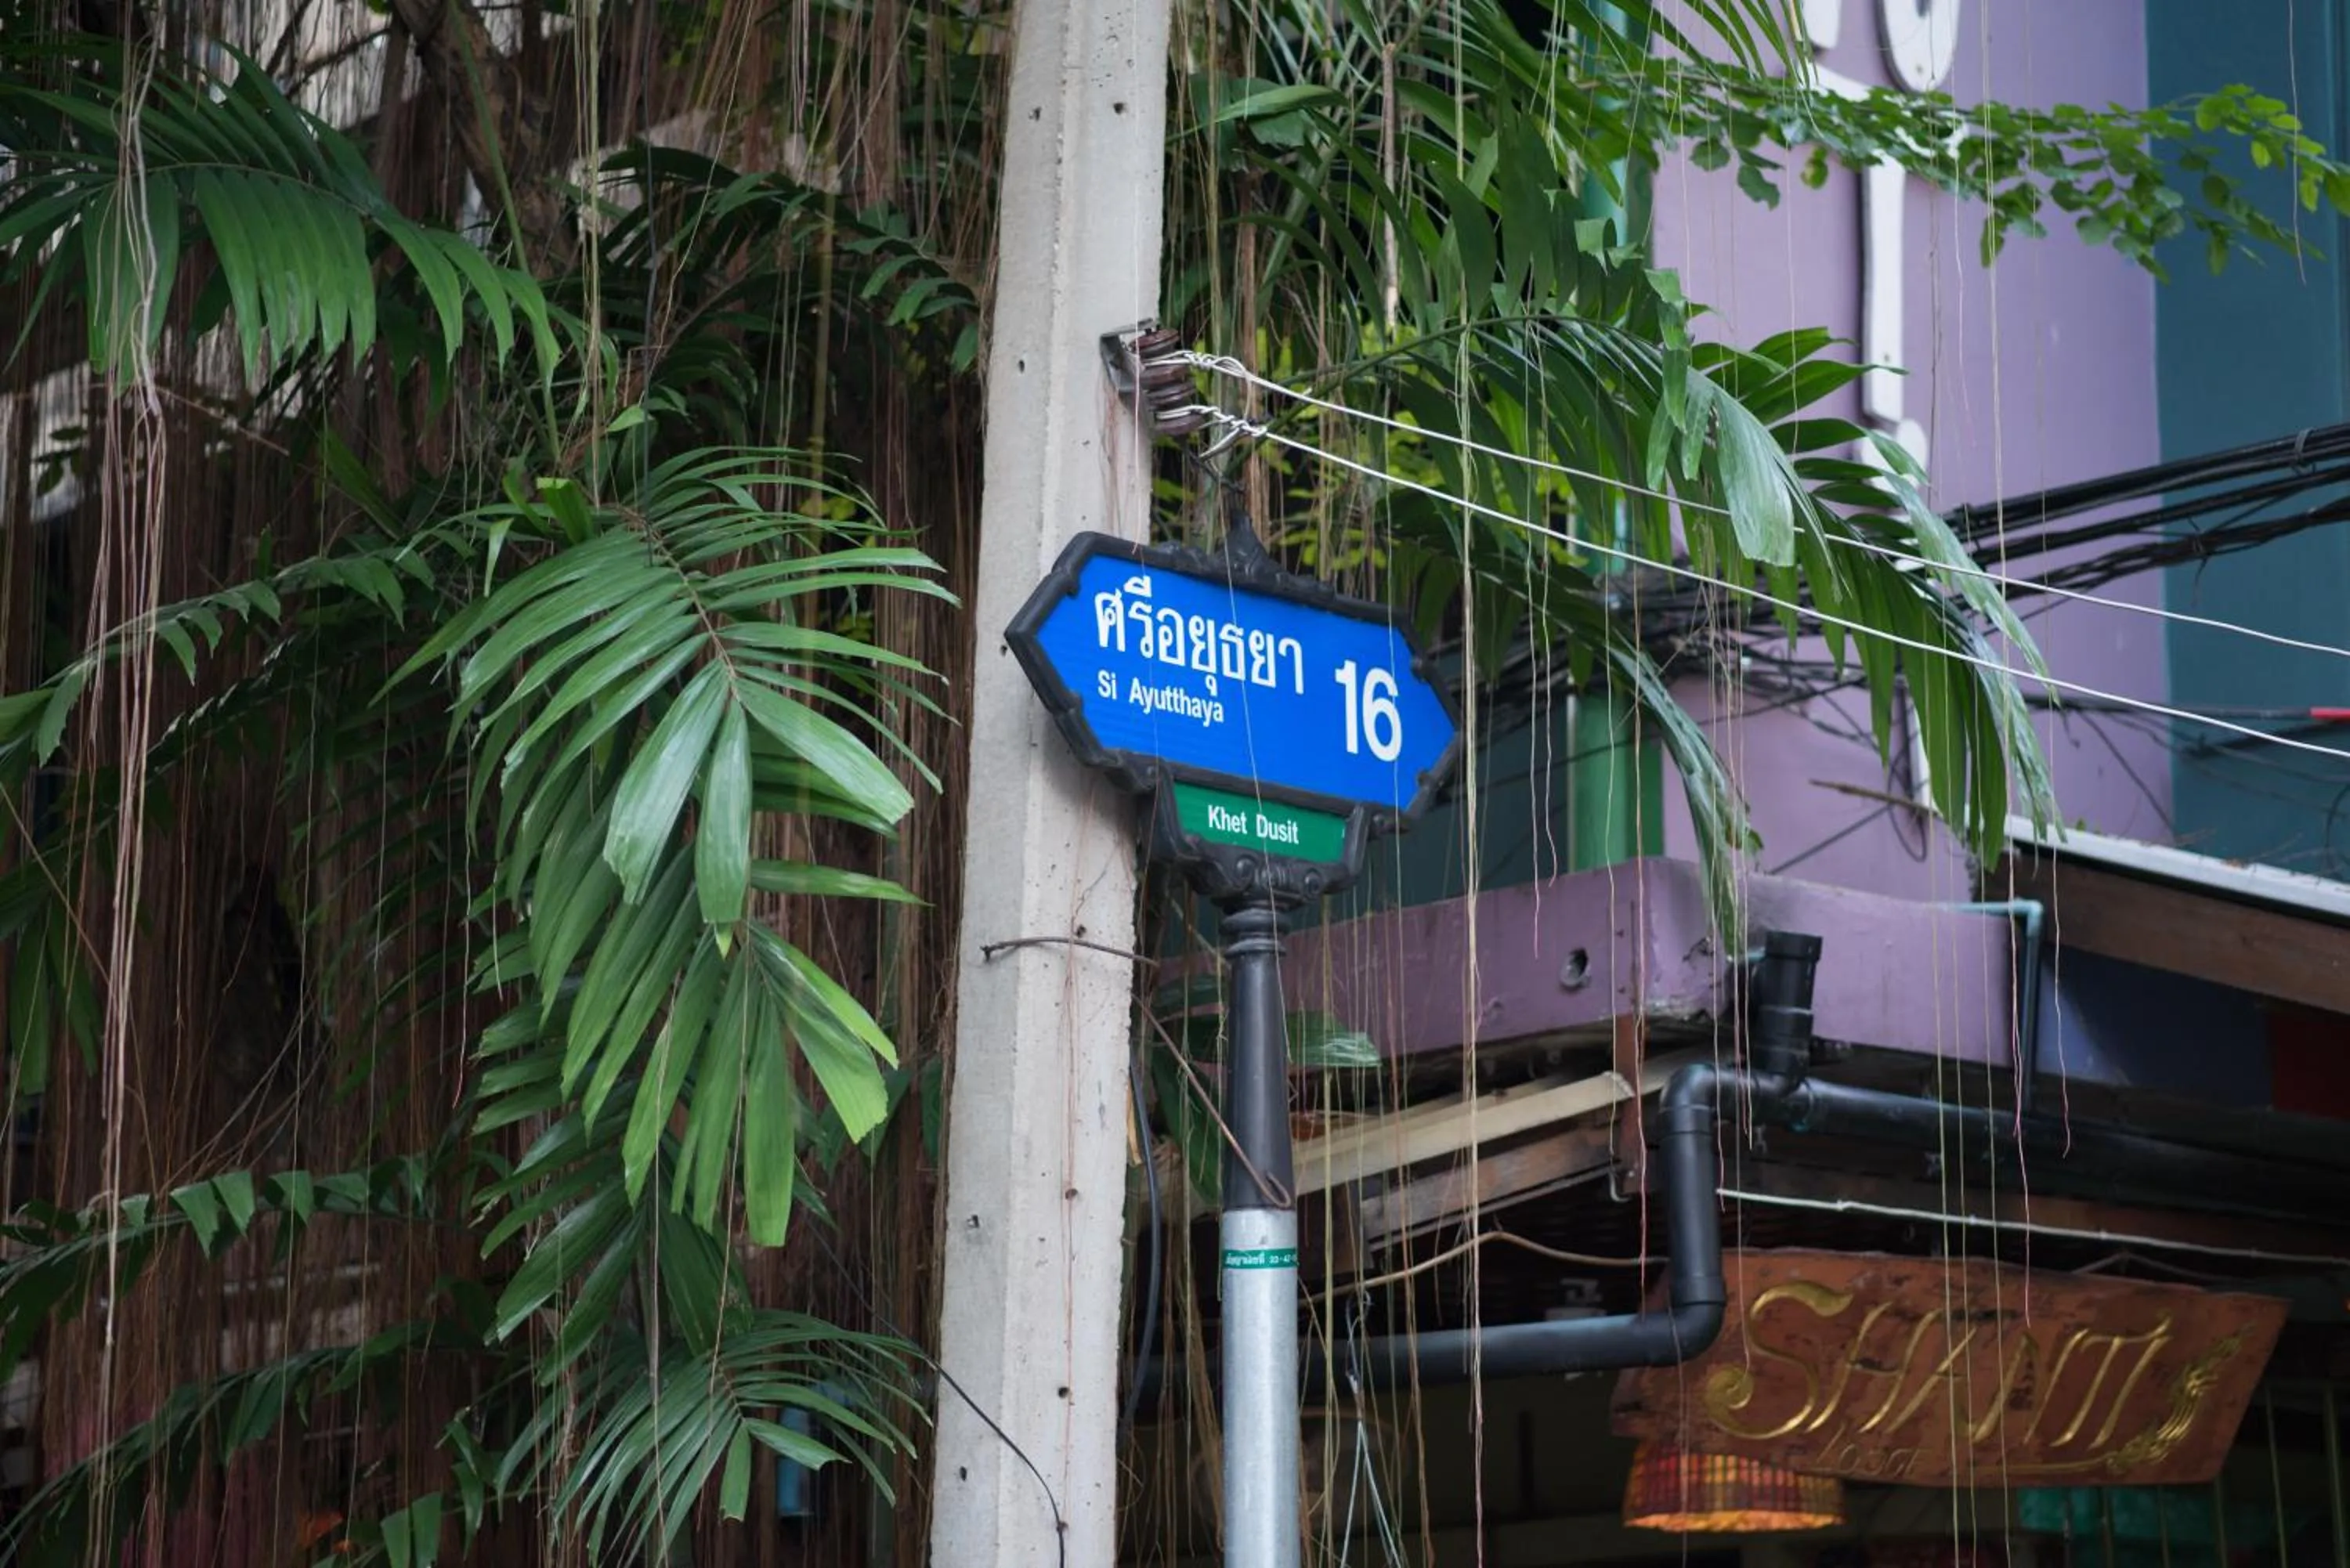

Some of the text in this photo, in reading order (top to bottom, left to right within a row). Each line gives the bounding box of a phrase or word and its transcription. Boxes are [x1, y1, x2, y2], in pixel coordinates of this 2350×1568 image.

[1094, 576, 1304, 696] ศรีอยุธยา
[1097, 670, 1224, 727] Si Ayutthaya
[1335, 660, 1402, 762] 16
[1208, 804, 1300, 844] Khet Dusit
